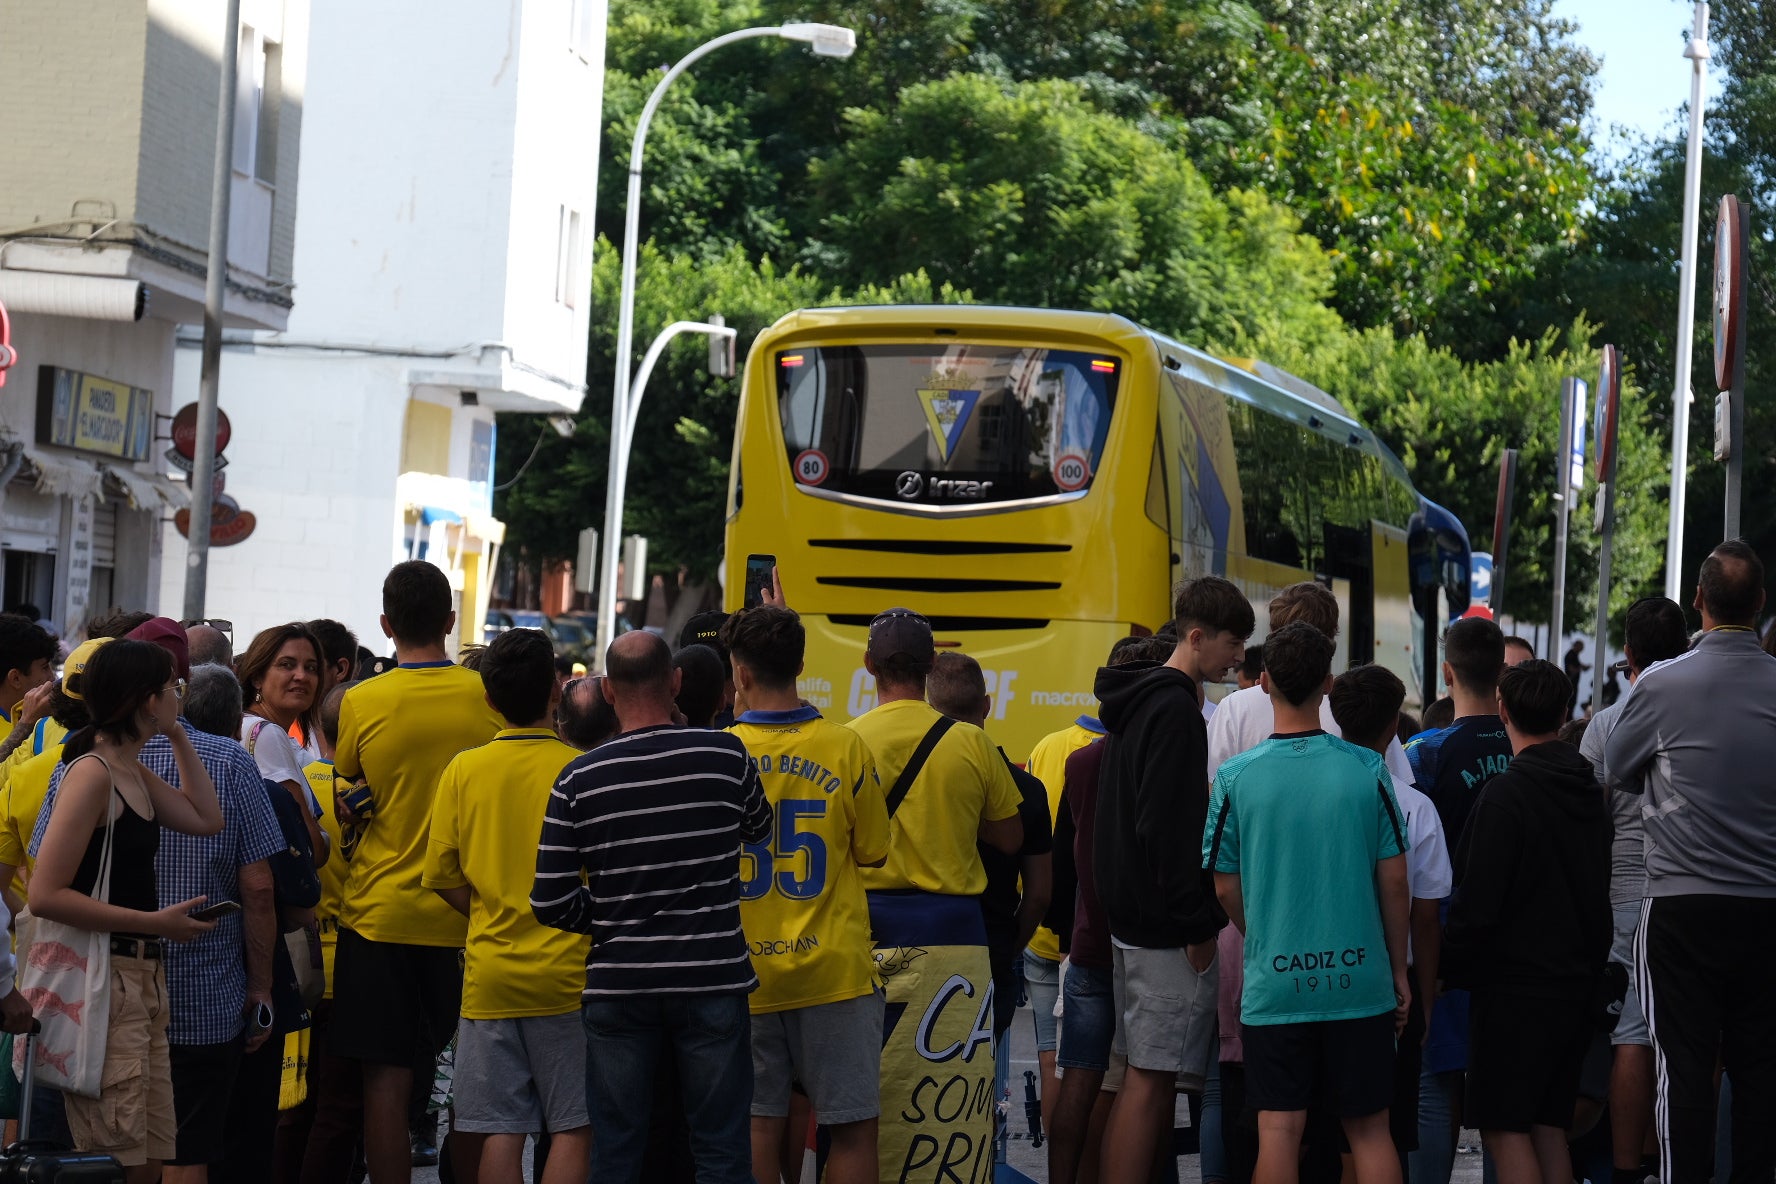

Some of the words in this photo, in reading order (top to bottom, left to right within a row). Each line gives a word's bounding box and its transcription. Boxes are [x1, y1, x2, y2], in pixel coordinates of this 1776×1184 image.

[803, 460, 819, 475] 80
[1061, 464, 1082, 479] 100
[780, 754, 841, 794] BENITO
[747, 934, 819, 956] OBCHAIN
[1272, 950, 1336, 973] CADIZ
[1340, 947, 1366, 967] CF
[1292, 973, 1351, 994] 1910
[899, 1131, 994, 1184] PRI
